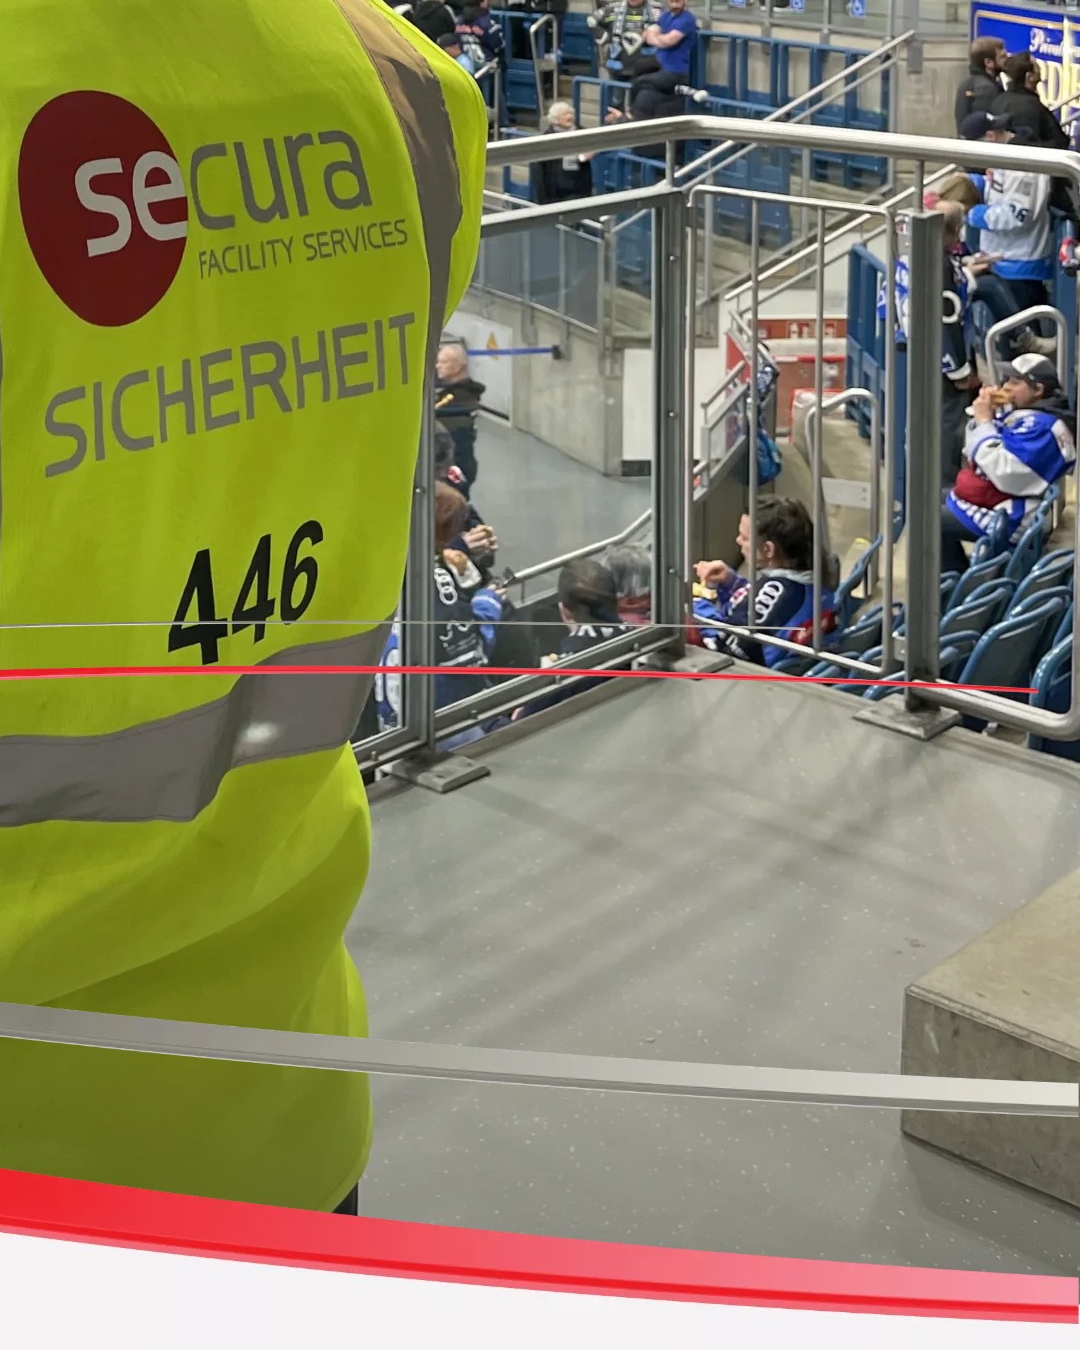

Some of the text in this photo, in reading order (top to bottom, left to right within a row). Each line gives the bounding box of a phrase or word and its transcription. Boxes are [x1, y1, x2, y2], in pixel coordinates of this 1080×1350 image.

[74, 129, 373, 258] secura
[198, 218, 408, 280] FACILITY SERVICES
[44, 312, 416, 478] SICHERHEIT
[167, 519, 324, 666] 446
